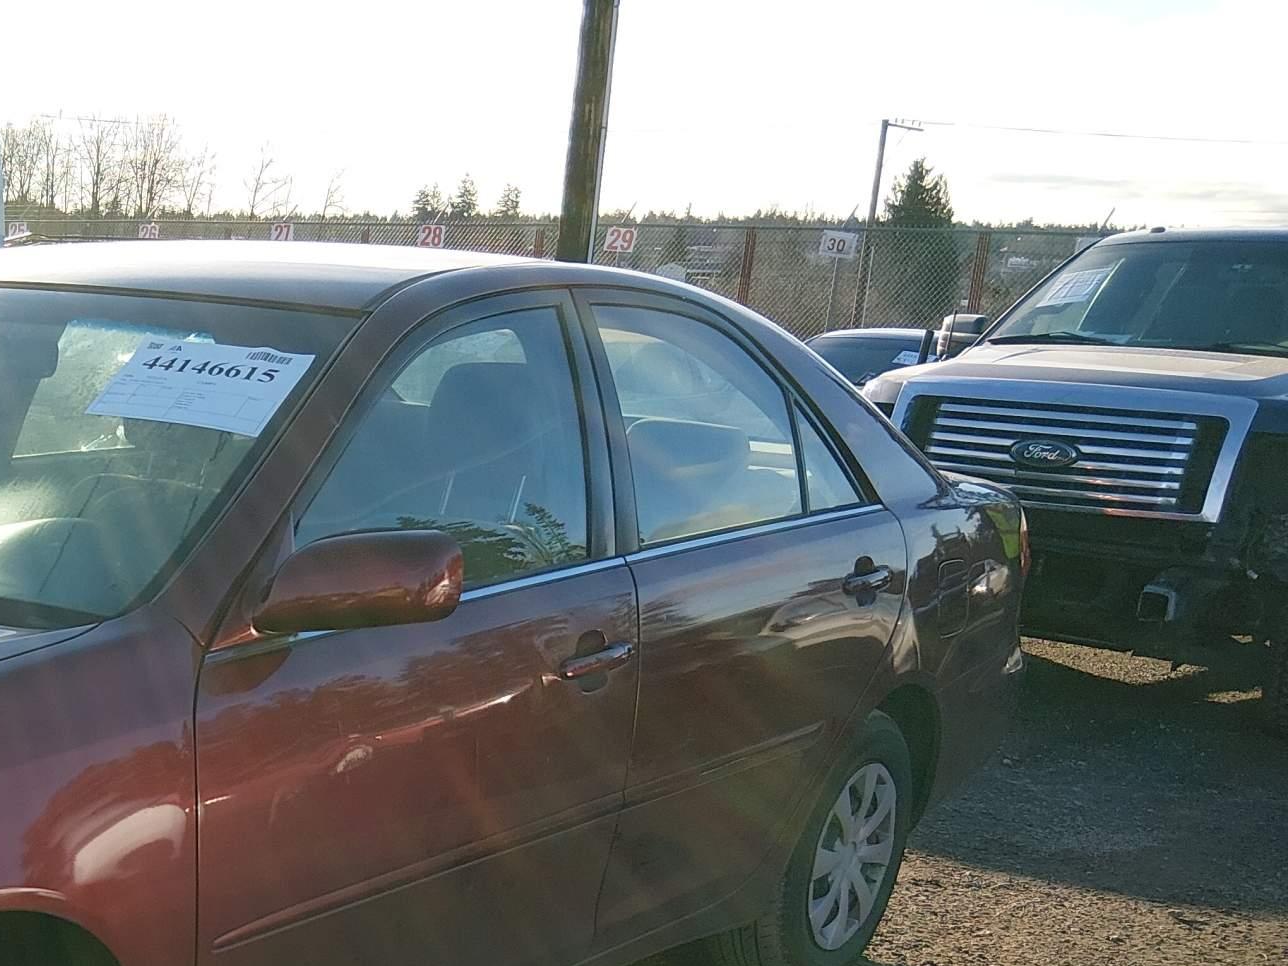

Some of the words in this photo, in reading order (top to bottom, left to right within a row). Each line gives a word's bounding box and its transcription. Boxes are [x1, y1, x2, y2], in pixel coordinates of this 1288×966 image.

[141, 225, 158, 238] 26
[274, 225, 291, 241] 27
[420, 226, 443, 247] 28
[606, 229, 634, 250] 29
[827, 238, 846, 251] 30
[142, 356, 280, 383] 44146615
[1024, 444, 1061, 459] Ford
